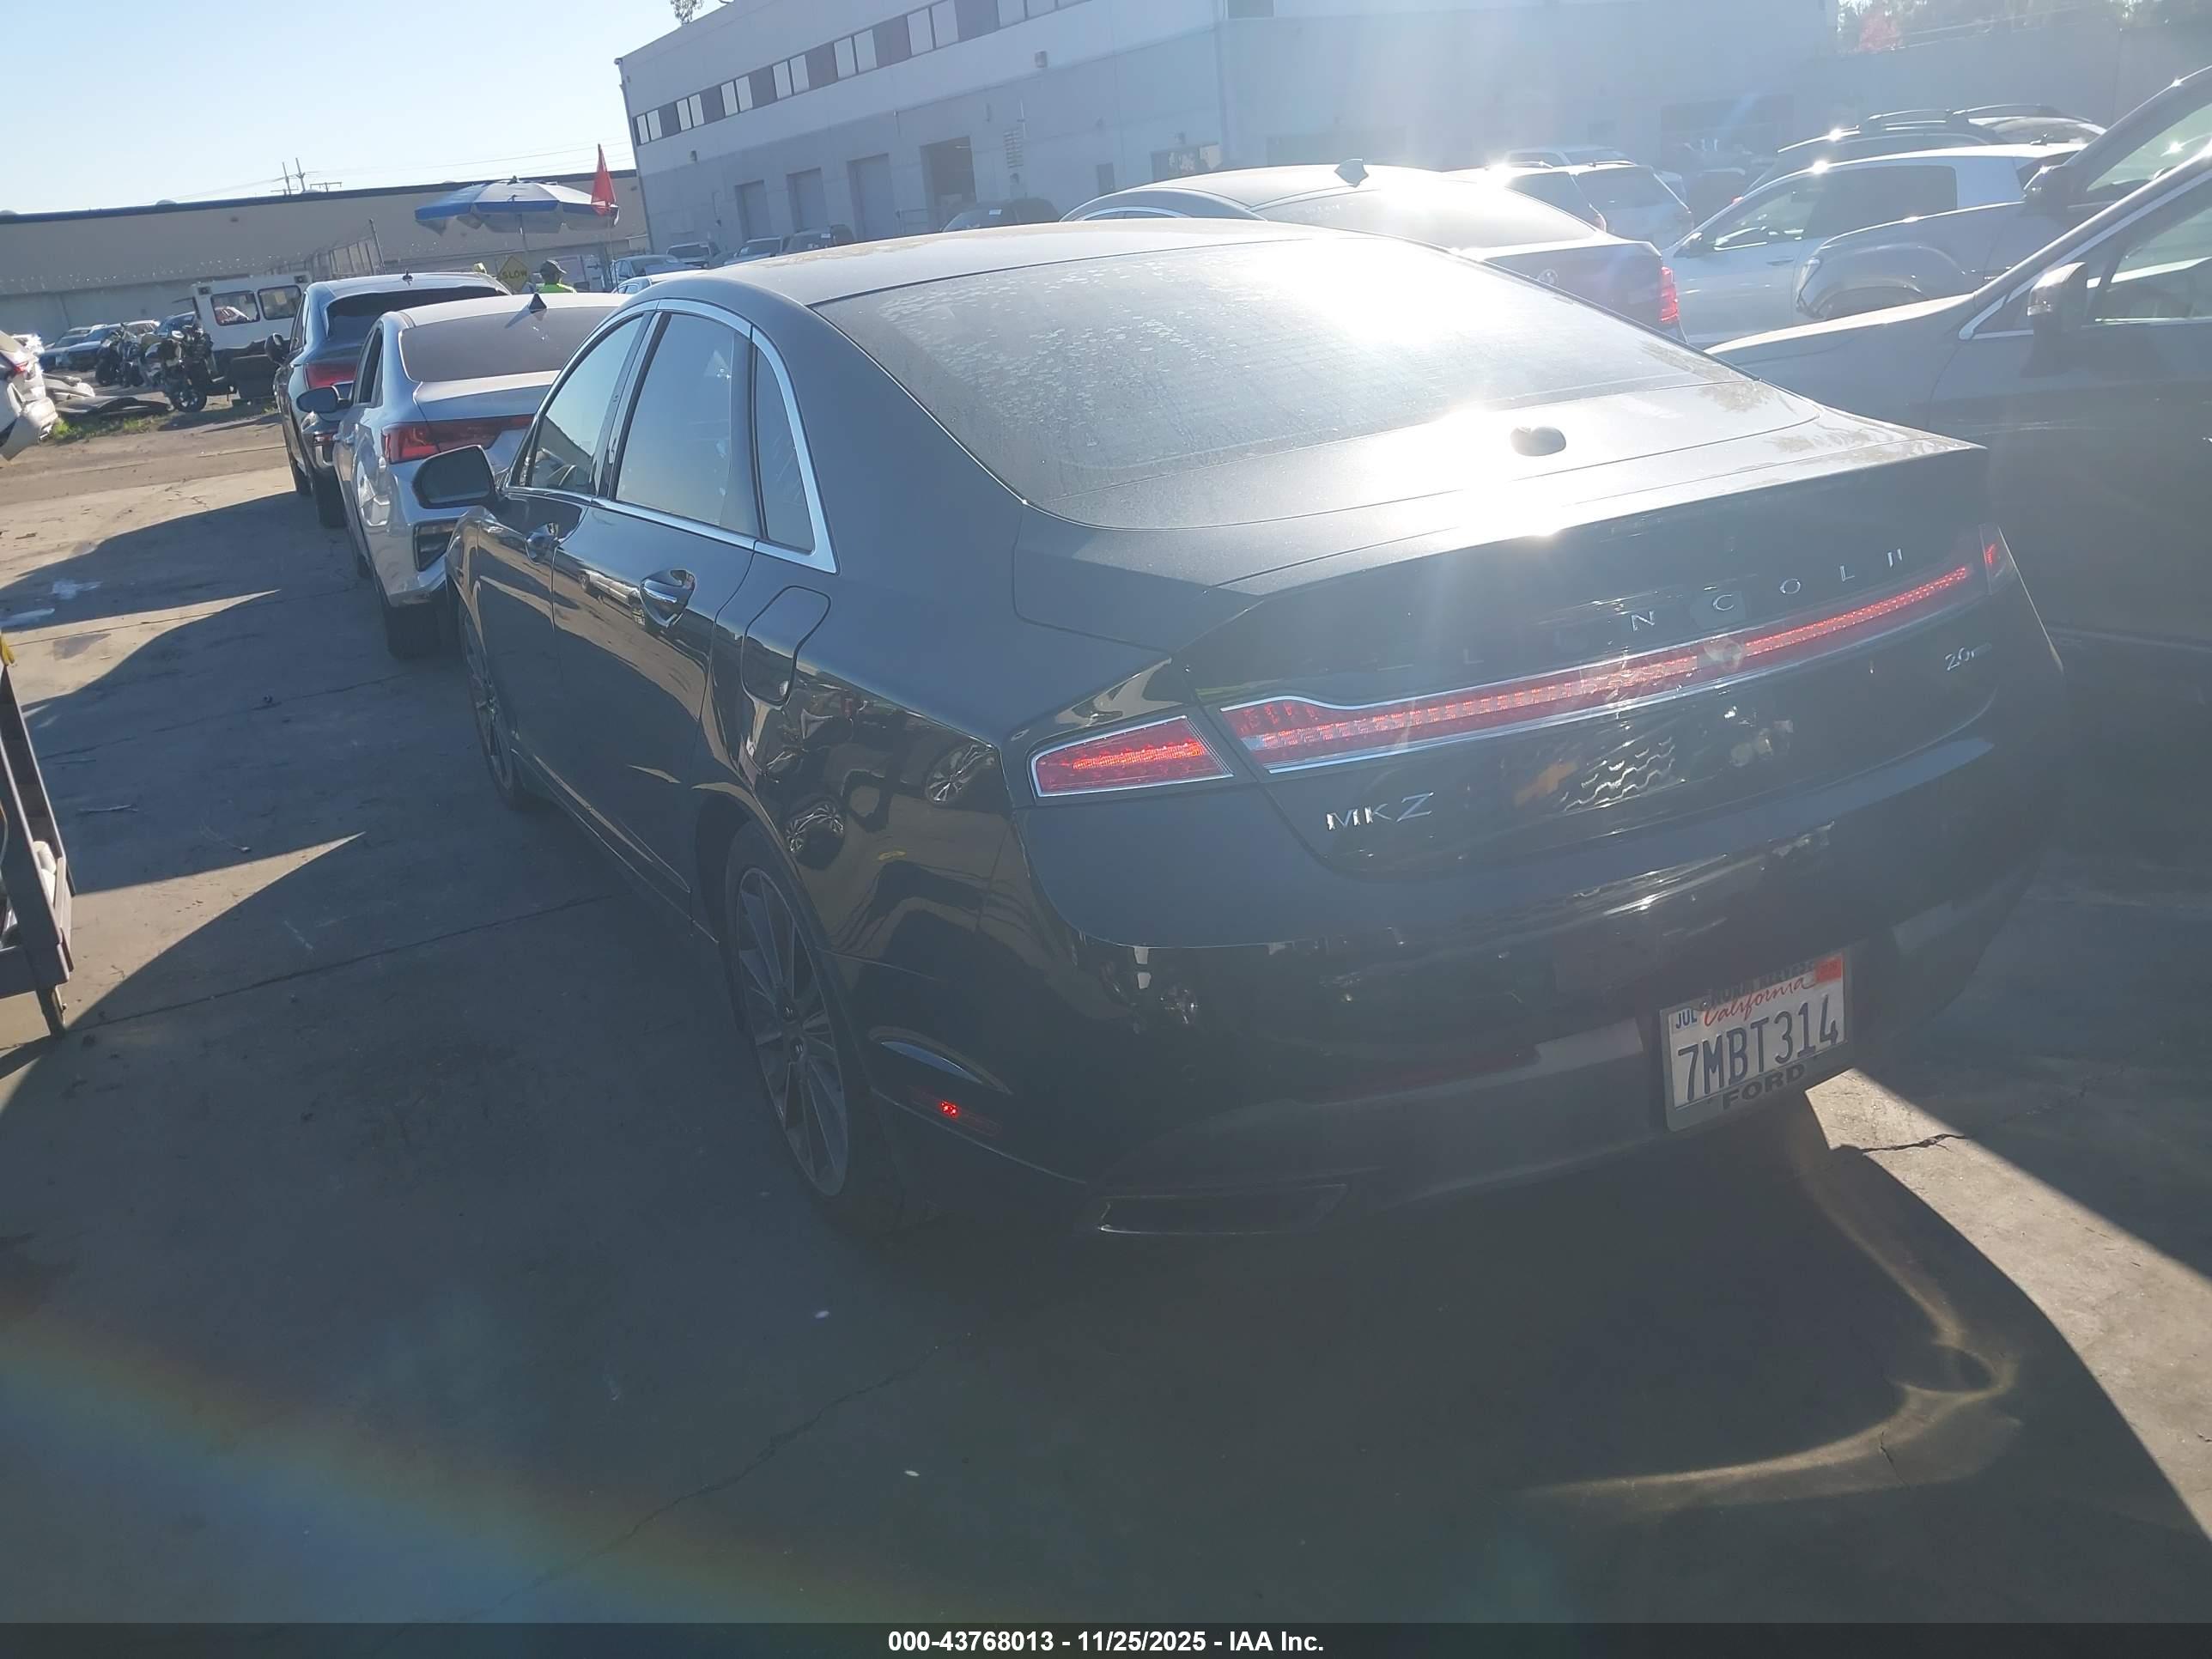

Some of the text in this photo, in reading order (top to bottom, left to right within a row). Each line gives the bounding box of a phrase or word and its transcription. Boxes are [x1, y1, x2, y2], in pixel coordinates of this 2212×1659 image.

[501, 270, 527, 279] SLOW
[1326, 791, 1435, 830] MKZ
[1675, 1009, 1698, 1030] JUL
[1704, 976, 1816, 1028] California
[1677, 994, 1838, 1102] 7MBT314
[1723, 1061, 1806, 1110] FORD
